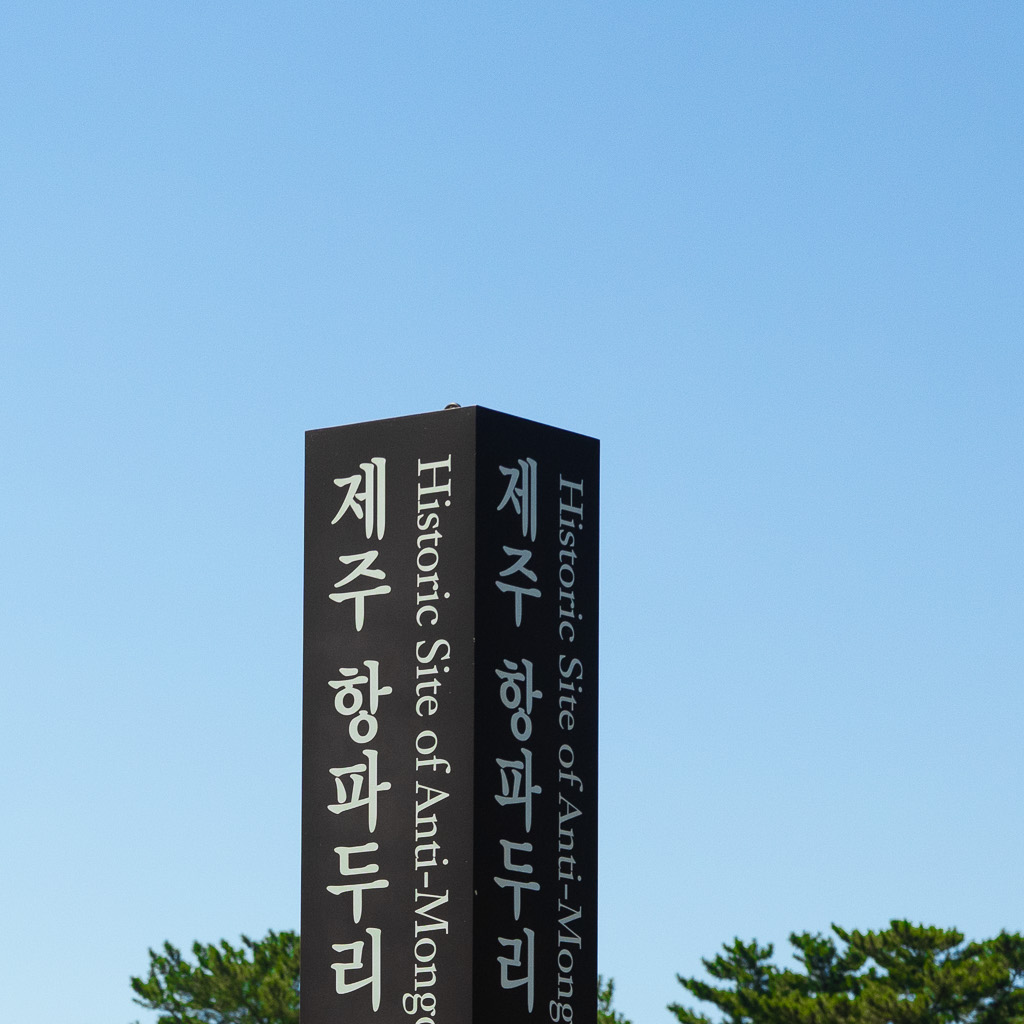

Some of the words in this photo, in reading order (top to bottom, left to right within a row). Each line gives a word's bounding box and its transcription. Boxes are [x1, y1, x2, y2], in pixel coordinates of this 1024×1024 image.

[328, 456, 392, 633] 제주
[415, 453, 452, 627] Historic
[494, 457, 542, 628] 제주
[558, 473, 584, 643] Historic
[415, 638, 451, 717] Site
[415, 729, 452, 774] of
[558, 654, 584, 731] Site
[325, 659, 393, 1013] 항파두리
[493, 658, 543, 1014] 항파두리
[557, 743, 584, 793] of
